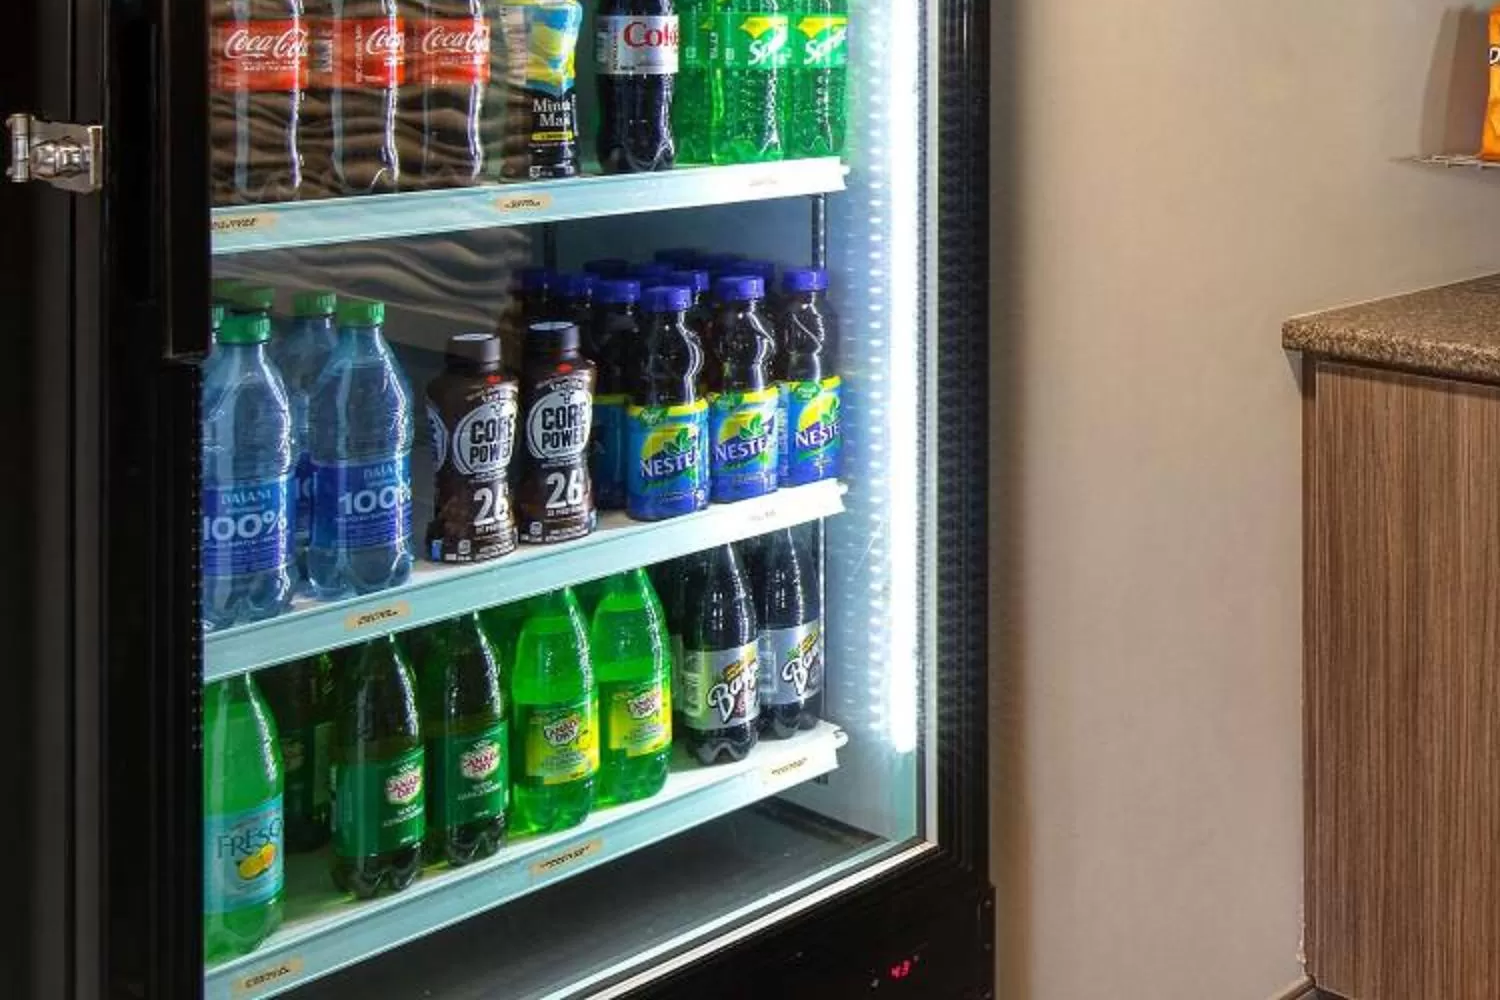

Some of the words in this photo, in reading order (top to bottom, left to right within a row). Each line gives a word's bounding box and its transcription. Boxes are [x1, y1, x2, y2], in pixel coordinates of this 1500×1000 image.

[541, 401, 588, 431] CORE
[473, 483, 510, 527] 26
[546, 467, 585, 509] 26
[203, 510, 288, 541] 100%
[216, 817, 283, 859] FRESC
